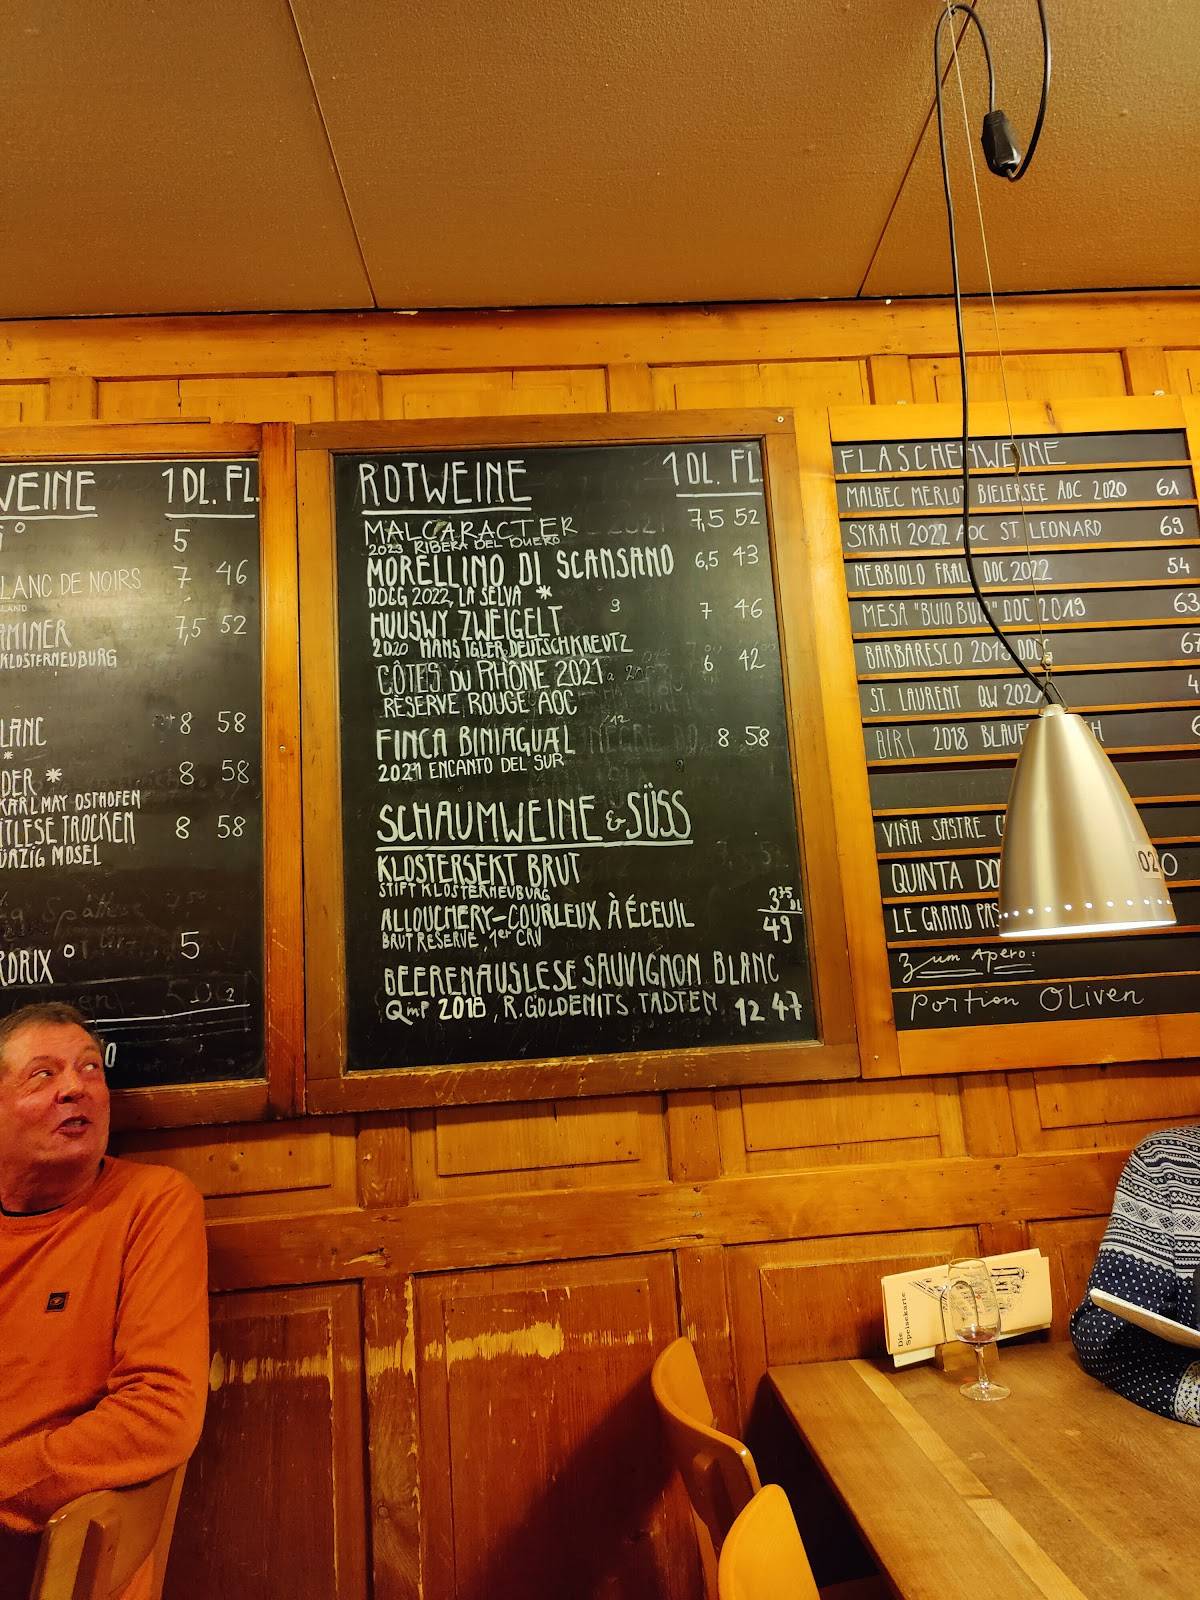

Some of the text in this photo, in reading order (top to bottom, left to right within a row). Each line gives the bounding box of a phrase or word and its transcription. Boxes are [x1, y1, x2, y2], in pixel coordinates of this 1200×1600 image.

[840, 441, 1067, 473] FLASCHENWEINE
[359, 459, 532, 507] ROTWEINE
[846, 486, 904, 508] MALBEC
[977, 483, 1049, 504] BIELERSEE
[1057, 480, 1082, 500] AOC
[1092, 479, 1128, 500] 2020
[1156, 478, 1180, 497] 61
[364, 516, 579, 546] MALCARACTER
[687, 507, 725, 533] 7,5
[733, 507, 761, 526] 52
[847, 522, 902, 548] SYRAH
[907, 523, 950, 547] 2022
[1029, 519, 1102, 540] LEONARD
[1160, 515, 1184, 536] 69
[172, 528, 191, 552] 5
[368, 535, 561, 556] 2023 RIBERA DEL DUERO
[366, 544, 675, 588] MORELLINO DI SCANSANO
[694, 544, 760, 571] 6,5 43
[854, 563, 926, 587] NEBBIOLO
[983, 560, 1009, 583] DOC
[1010, 559, 1052, 582] 2022
[1167, 557, 1190, 574] 54
[60, 572, 83, 594] DE
[89, 567, 142, 593] NOIRS
[173, 559, 249, 589] 7 46
[367, 586, 408, 609] DOCG
[458, 585, 477, 608] LA
[479, 584, 523, 608] SELVA
[699, 598, 763, 620] 7 46
[862, 602, 908, 628] MESA
[1003, 598, 1034, 622] DOC
[1038, 597, 1086, 621] 2019
[1173, 592, 1200, 613] 63
[175, 614, 247, 647] 7,5 52
[369, 605, 564, 641] HUUSWY ZWEIGELT
[371, 637, 409, 658] 2020
[420, 637, 461, 659] HANS
[508, 632, 634, 659] DEUTSCHKREUTZ
[703, 647, 766, 672] 6 42
[865, 642, 963, 669] BARBARESCO
[377, 660, 441, 696] CÔTES
[476, 659, 551, 692] RHÔNE
[554, 658, 603, 687] 2021
[467, 690, 531, 716] ROUGE
[538, 689, 578, 716] AOC
[870, 688, 892, 713] ST.
[898, 686, 962, 712] LAURENT
[179, 711, 246, 735] 8 58
[717, 727, 730, 748] 8
[744, 726, 770, 748] 58
[376, 727, 448, 761] FINCA
[458, 724, 576, 758] BINIAGUAL
[876, 729, 916, 760] BIRI
[933, 727, 969, 751] 2018
[179, 759, 250, 785] 8 58
[429, 757, 494, 780] ENCANTO
[500, 756, 528, 775] DEL
[534, 752, 566, 772] SUR
[41, 794, 69, 814] MAY
[74, 789, 141, 811] OSTHOFEN
[376, 794, 604, 843] SCHAUMWEINE
[625, 782, 692, 840] SÜSS
[62, 811, 136, 845] TROCKEN
[175, 815, 246, 840] 8 58
[881, 819, 922, 848] VIÑA
[931, 817, 986, 841] SASTRE
[51, 844, 102, 867] MOSEL
[377, 851, 581, 889] KLOSTERSEKT BRUT
[891, 860, 964, 893] QUINTA
[378, 882, 551, 902] STIFT KLOSTERNEUBURG
[625, 894, 696, 929] ÉCEUIL
[892, 907, 917, 933] LE
[921, 904, 973, 932] GRAND
[382, 930, 414, 952] BRUT
[762, 915, 793, 944] 49
[181, 931, 200, 960] 5
[384, 950, 780, 998] BEERENAUSLESE SAUVIGNON BLANC
[899, 953, 961, 983] Zum
[637, 989, 718, 1017] TADTEN
[734, 990, 803, 1027] 12 47
